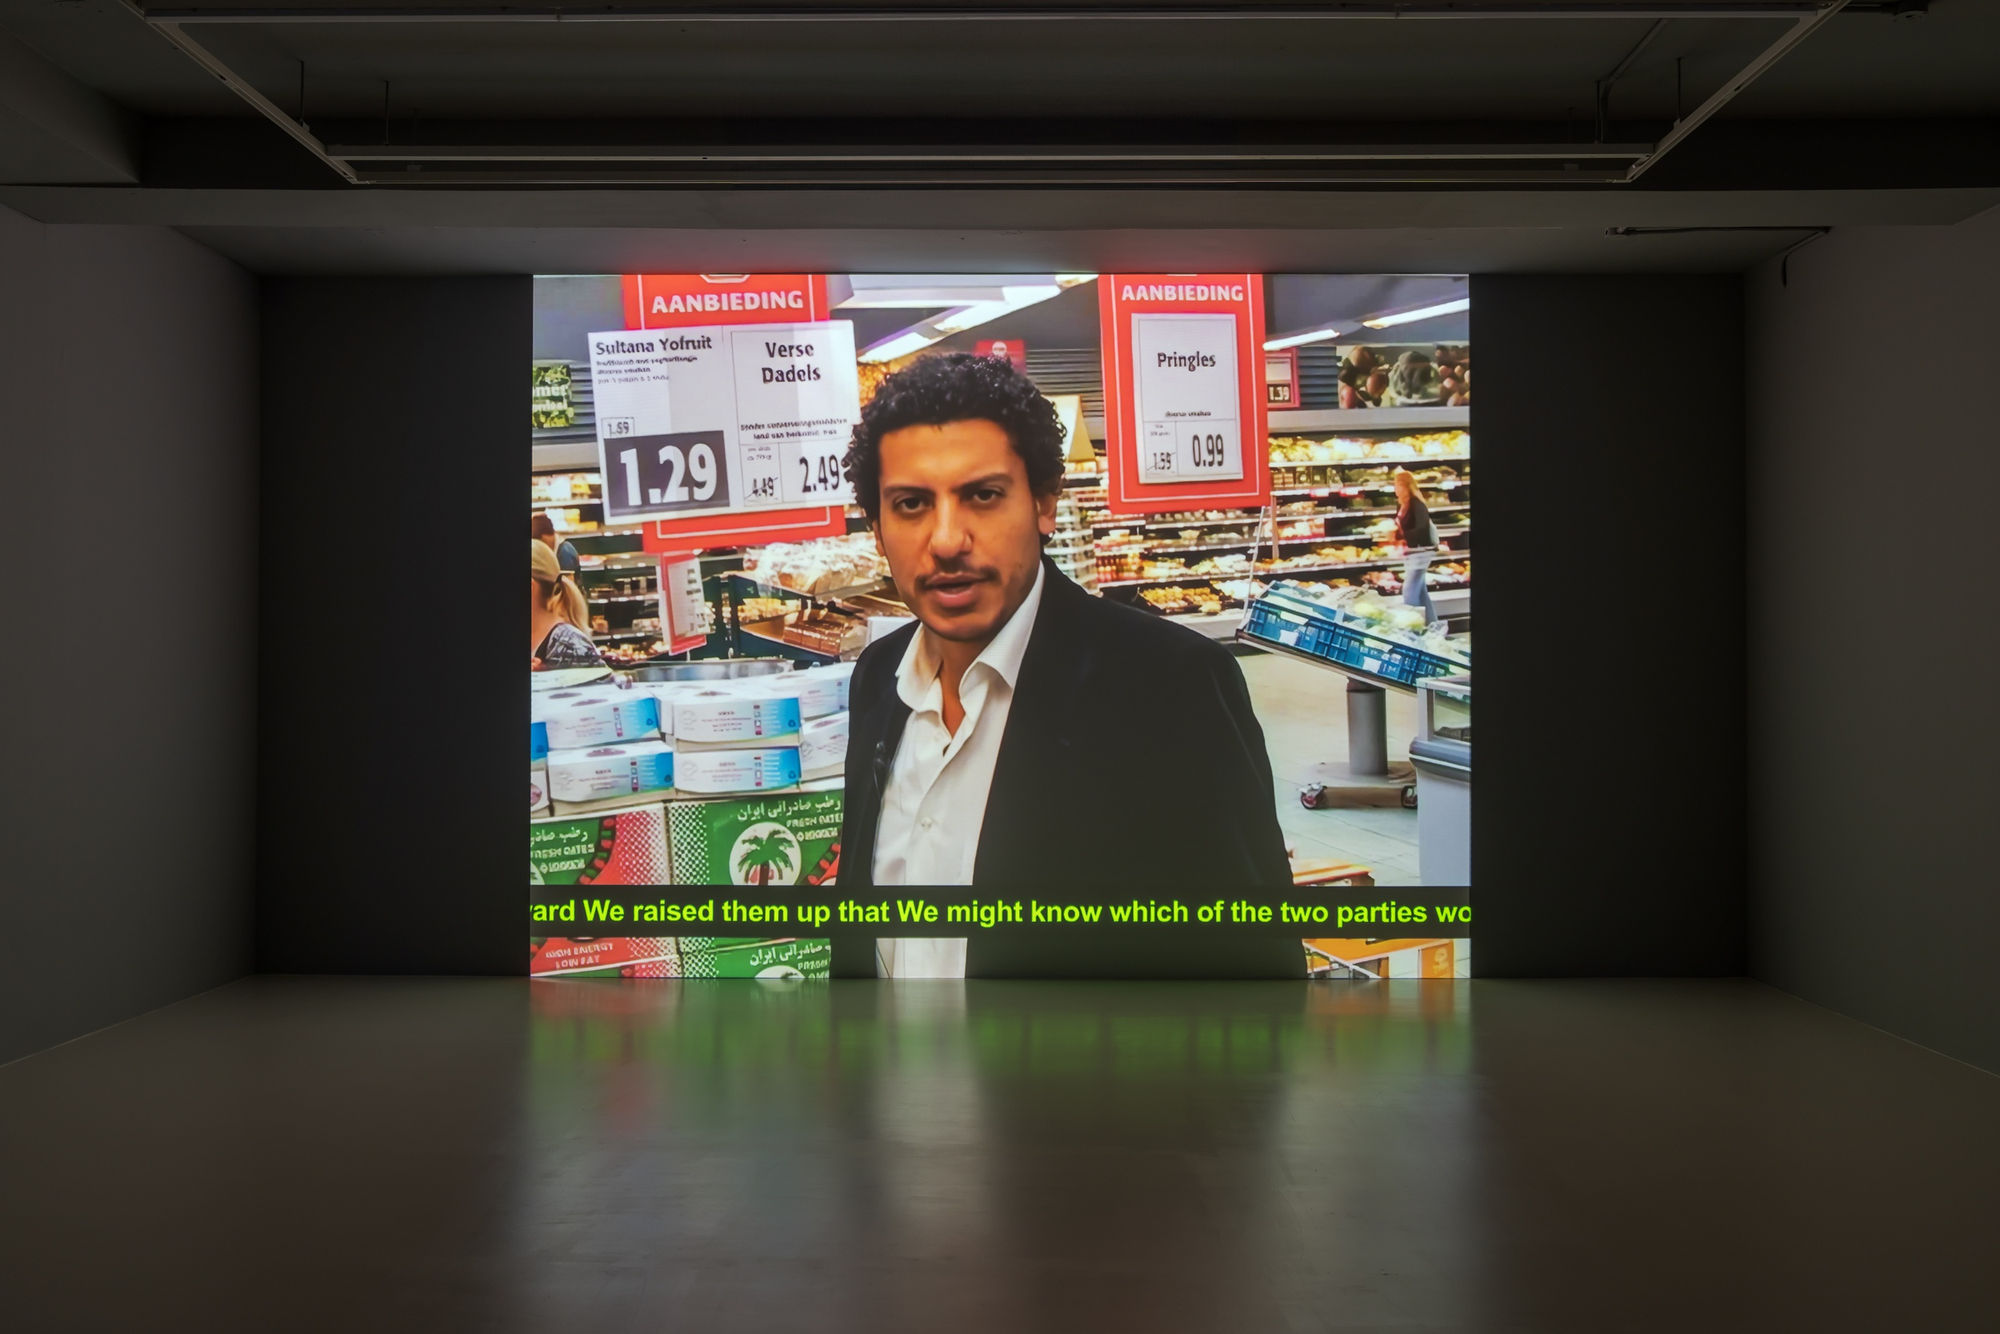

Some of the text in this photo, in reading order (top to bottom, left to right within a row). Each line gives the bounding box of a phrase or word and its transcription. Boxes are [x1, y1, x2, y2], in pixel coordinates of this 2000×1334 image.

[651, 291, 804, 314] AANBIEDING
[1121, 284, 1244, 301] AANBIEDING
[595, 335, 713, 356] Sultana Yofruit
[765, 342, 814, 358] Verse
[1156, 350, 1216, 372] Pringles
[761, 363, 822, 385] Dadels
[1192, 433, 1224, 468] 0.99
[620, 443, 718, 507] 1.29
[799, 454, 840, 493] 2.49
[737, 803, 765, 821] ایران
[529, 899, 576, 922] ard
[582, 899, 625, 922] We
[633, 899, 714, 922] raised
[721, 899, 789, 923] them
[797, 904, 831, 928] up
[837, 899, 891, 923] that
[896, 899, 939, 923] We
[947, 899, 1024, 929] might
[1031, 899, 1103, 923] know
[1108, 899, 1189, 923] which
[1197, 899, 1225, 923] of
[1230, 900, 1273, 923] the
[1279, 901, 1329, 923] two
[1337, 900, 1428, 929] parties
[555, 955, 601, 969] LOW FAT
